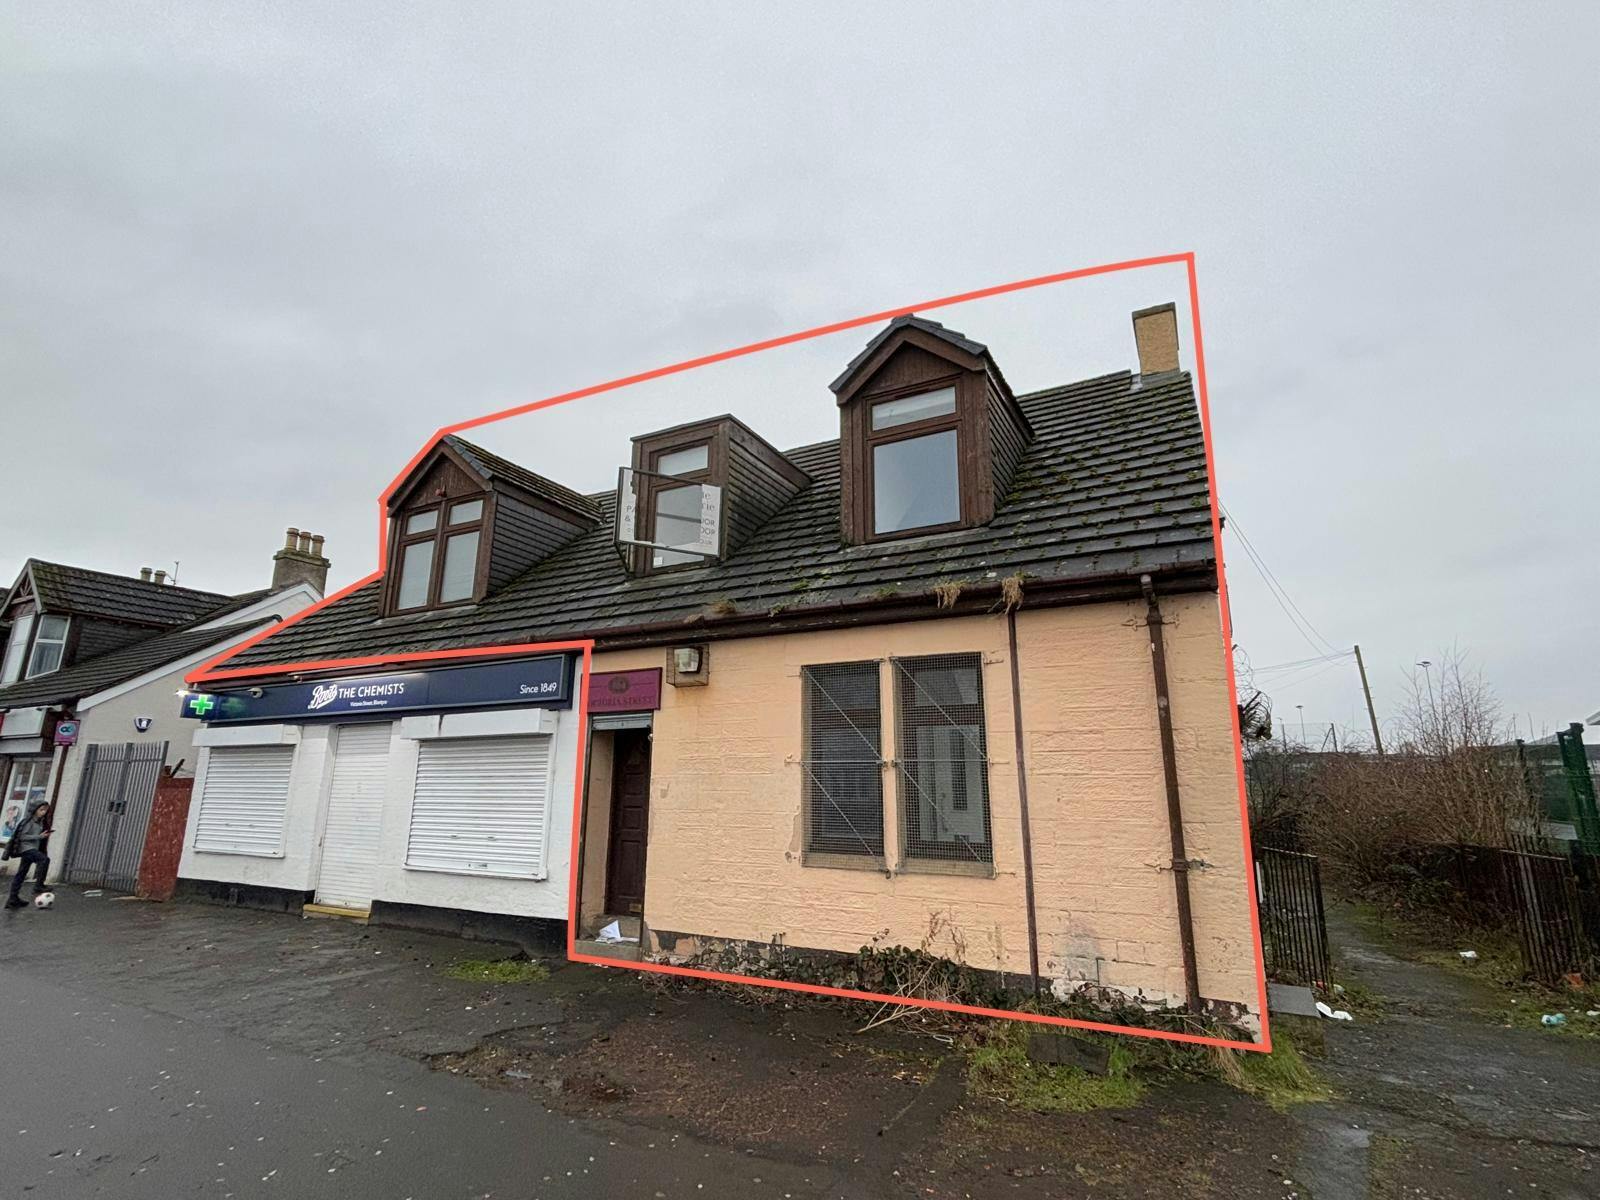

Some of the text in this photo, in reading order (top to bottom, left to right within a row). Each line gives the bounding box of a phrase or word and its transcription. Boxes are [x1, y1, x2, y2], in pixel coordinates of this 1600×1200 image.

[307, 682, 405, 709] Boots THE CHEMISTS
[519, 681, 557, 694] Since 1849
